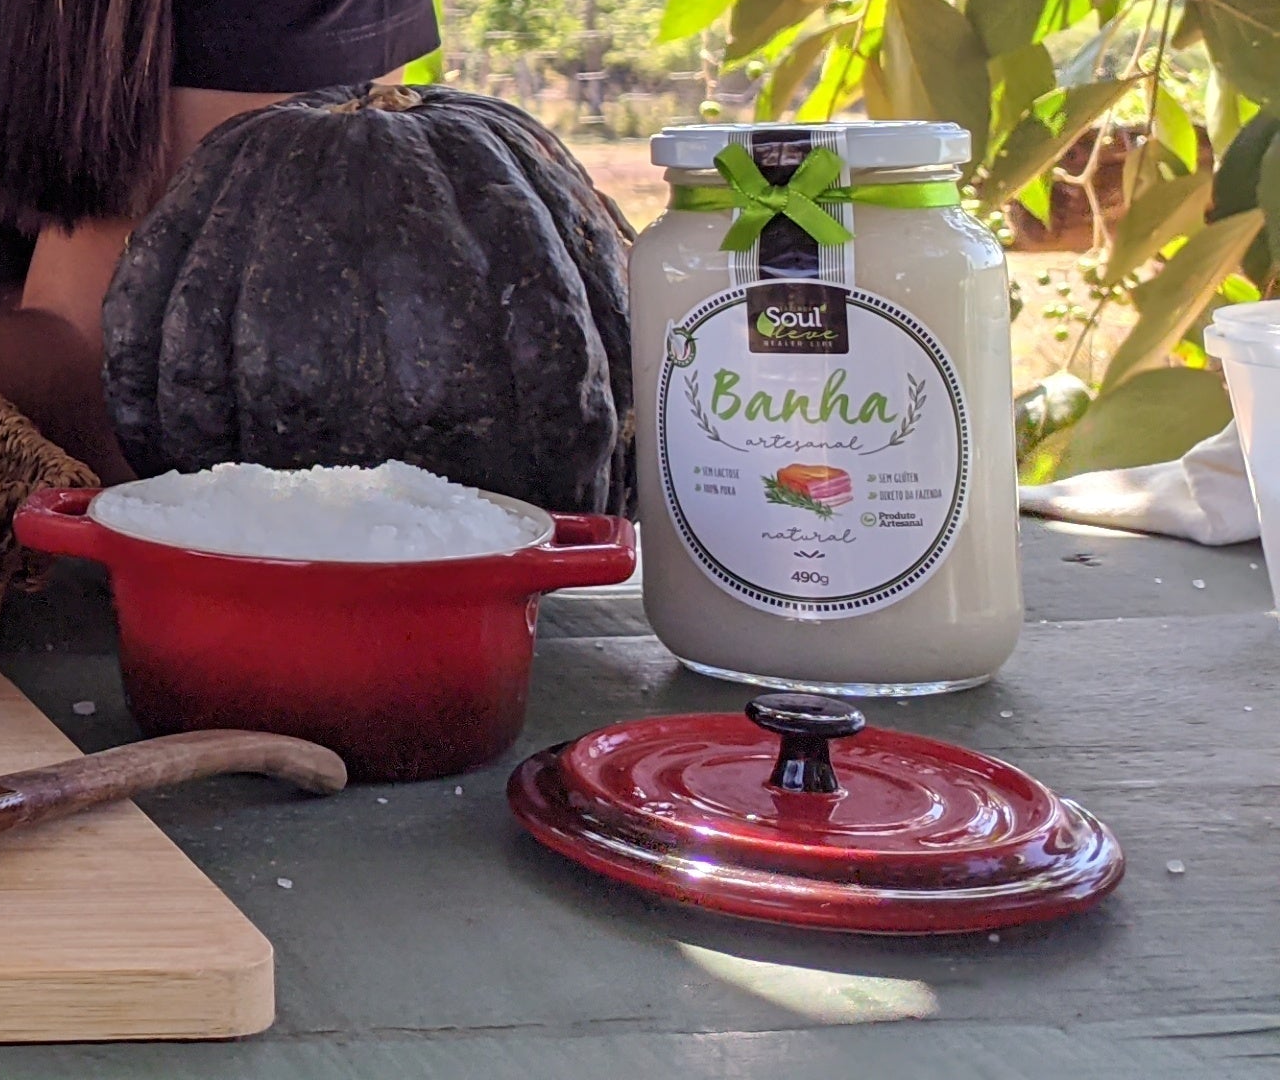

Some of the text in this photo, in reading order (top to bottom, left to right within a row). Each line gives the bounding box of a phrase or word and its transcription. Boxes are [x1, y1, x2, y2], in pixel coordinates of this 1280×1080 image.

[766, 306, 823, 328] Soul
[711, 368, 898, 425] Banha
[745, 434, 864, 452] artesanal
[878, 512, 916, 520] Produto
[879, 518, 924, 528] Artesanal
[761, 527, 857, 544] natural
[791, 571, 829, 586] 490g
